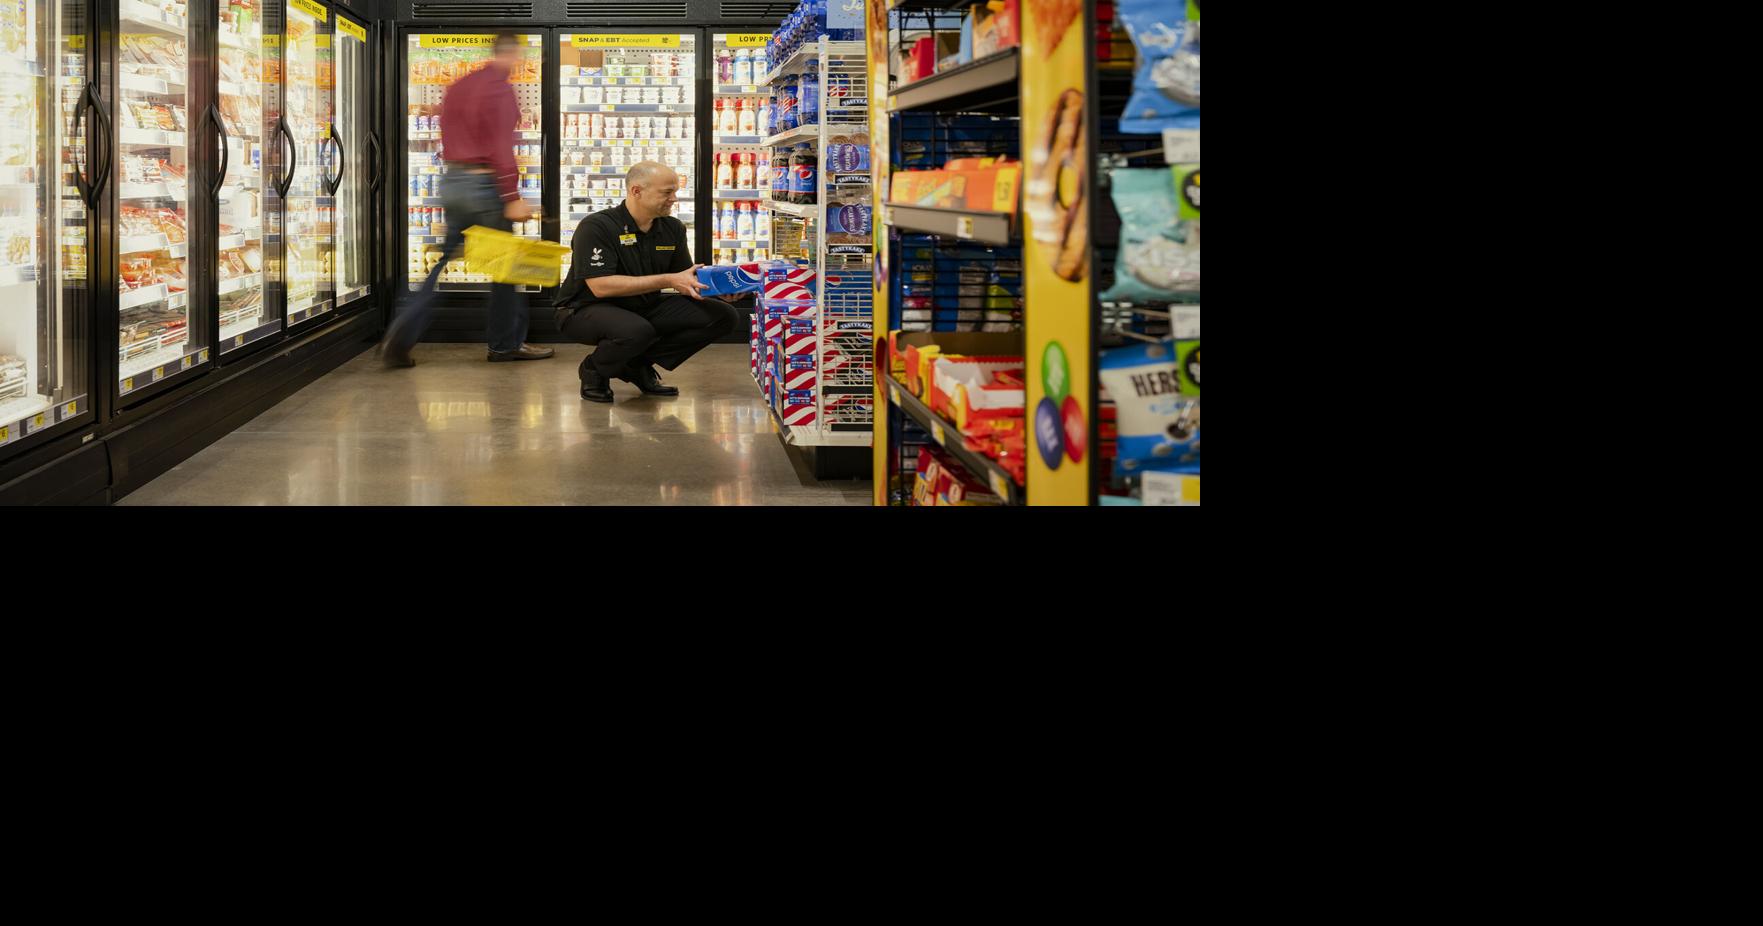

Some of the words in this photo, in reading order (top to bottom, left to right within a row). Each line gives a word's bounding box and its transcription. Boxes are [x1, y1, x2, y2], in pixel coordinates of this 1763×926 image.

[837, 175, 870, 183] TASTYKAKE
[830, 245, 865, 253] TASTYKAKE
[725, 270, 741, 288] pepsi
[1132, 369, 1179, 397] HERS
